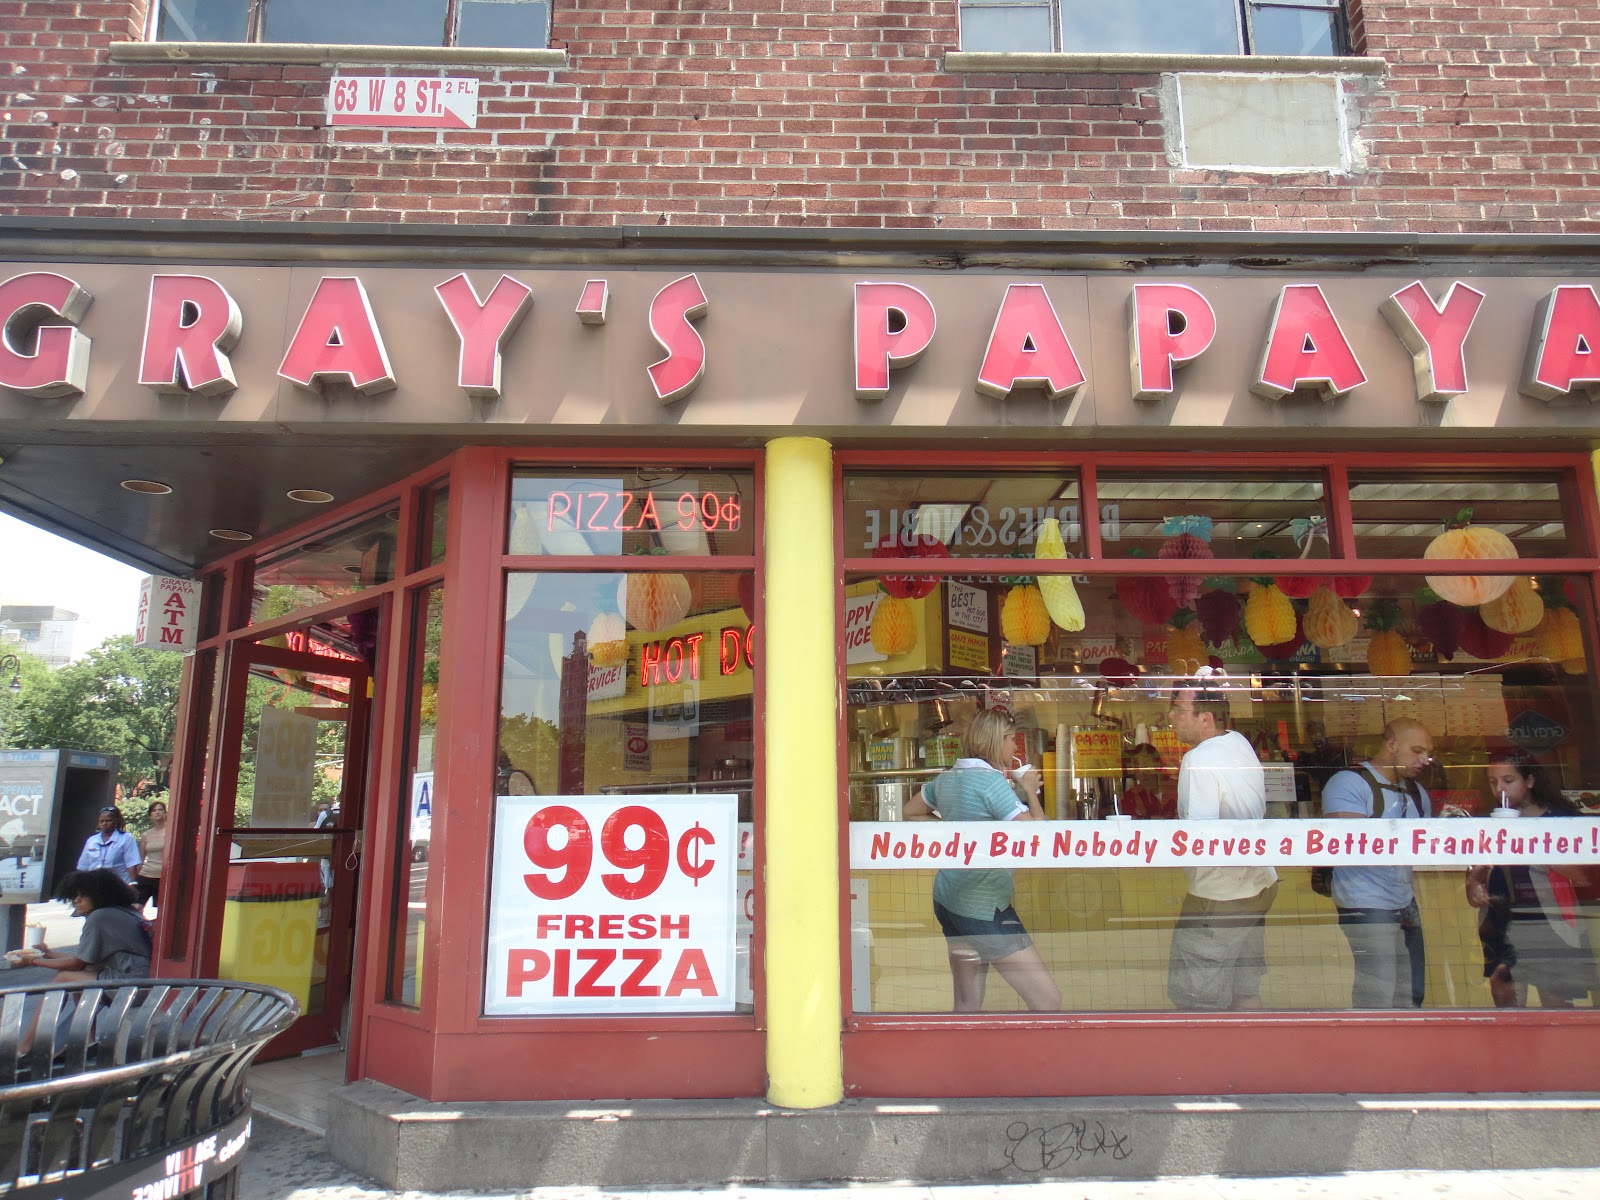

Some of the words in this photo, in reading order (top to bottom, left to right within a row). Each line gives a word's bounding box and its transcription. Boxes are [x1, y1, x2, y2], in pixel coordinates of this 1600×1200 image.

[334, 79, 358, 112] 63
[369, 79, 386, 112] W
[393, 80, 406, 113] 8
[415, 79, 442, 113] ST.
[445, 82, 452, 93] 2
[458, 82, 474, 94] FL.
[0, 271, 708, 399] GRAY'S
[854, 280, 1600, 402] PAPAYA
[547, 491, 662, 532] PIZZA
[160, 584, 194, 594] PAPAYA
[951, 592, 976, 608] BEST
[160, 592, 186, 644] ATM
[641, 634, 704, 687] HOT
[523, 805, 715, 900] 99¢
[870, 831, 977, 865] Nobody
[989, 832, 1040, 858] But
[1052, 830, 1158, 863] Nobody
[1170, 830, 1266, 857] Serves
[1279, 837, 1293, 856] a
[1306, 829, 1399, 855] Better
[536, 914, 690, 939] FRESH
[505, 949, 719, 997] PIZZA
